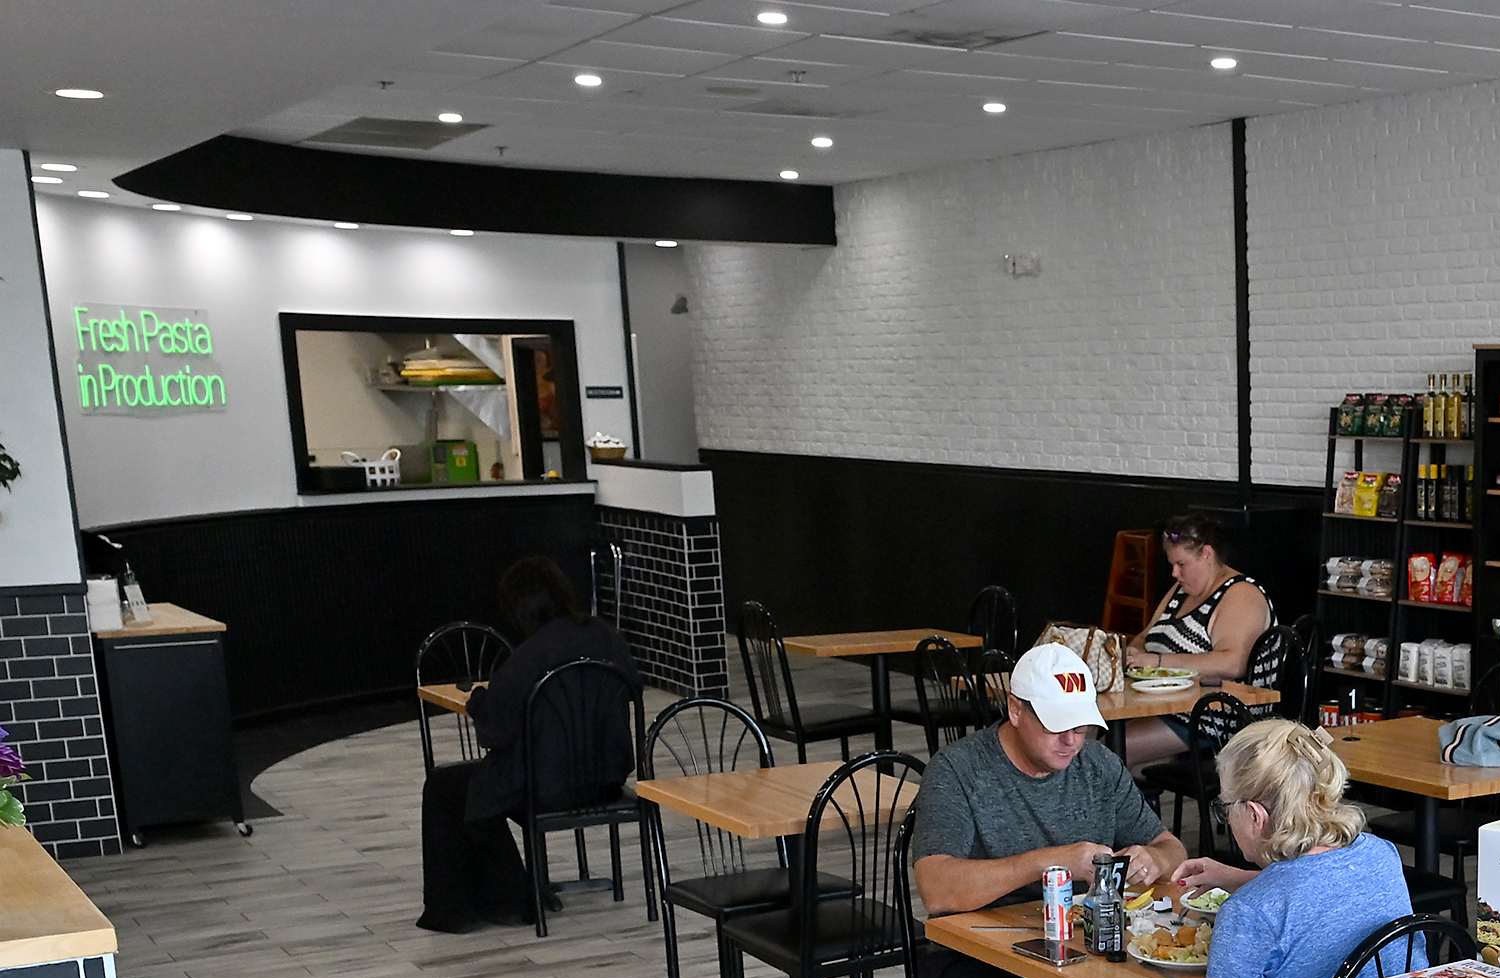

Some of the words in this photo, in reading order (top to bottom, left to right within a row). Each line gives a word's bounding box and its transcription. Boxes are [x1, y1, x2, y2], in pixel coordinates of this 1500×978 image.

[74, 307, 140, 352] Fresh
[140, 311, 213, 354] Pasta
[78, 364, 99, 407] in
[98, 364, 226, 406] Production
[1348, 688, 1357, 710] 1
[1111, 862, 1124, 889] 5
